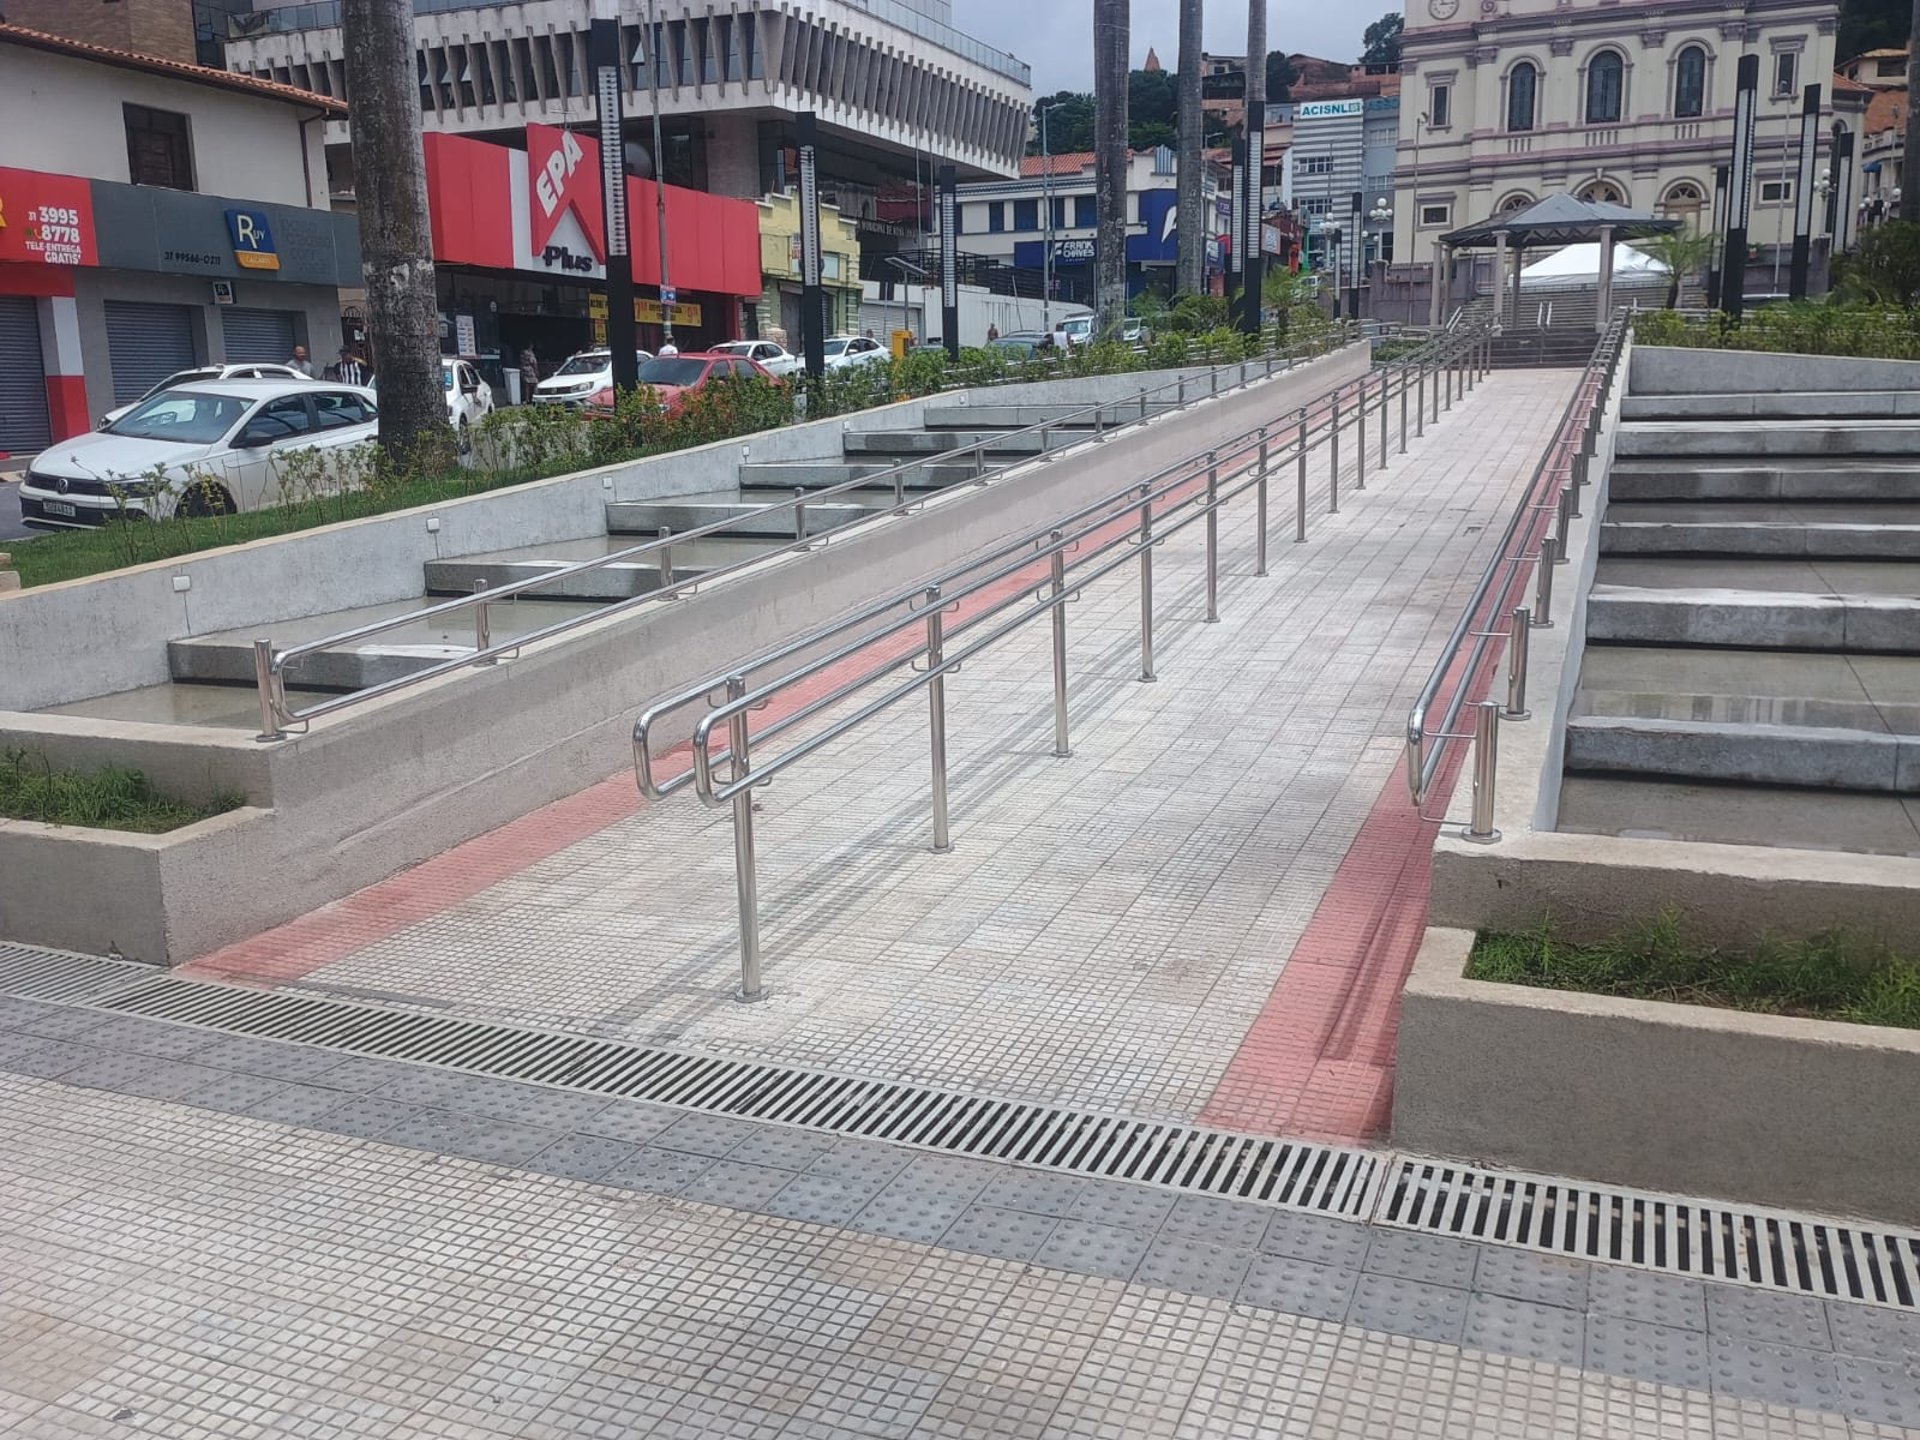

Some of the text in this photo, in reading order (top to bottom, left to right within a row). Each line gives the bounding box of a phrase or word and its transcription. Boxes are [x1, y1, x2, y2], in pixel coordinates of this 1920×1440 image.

[1302, 103, 1347, 116] ACISNL
[536, 130, 584, 219] EPA
[38, 206, 79, 226] 3995
[41, 224, 80, 243] 8778
[25, 241, 82, 253] TELE-ENTREGA
[1063, 241, 1095, 251] FRANK
[542, 246, 593, 272] Plus
